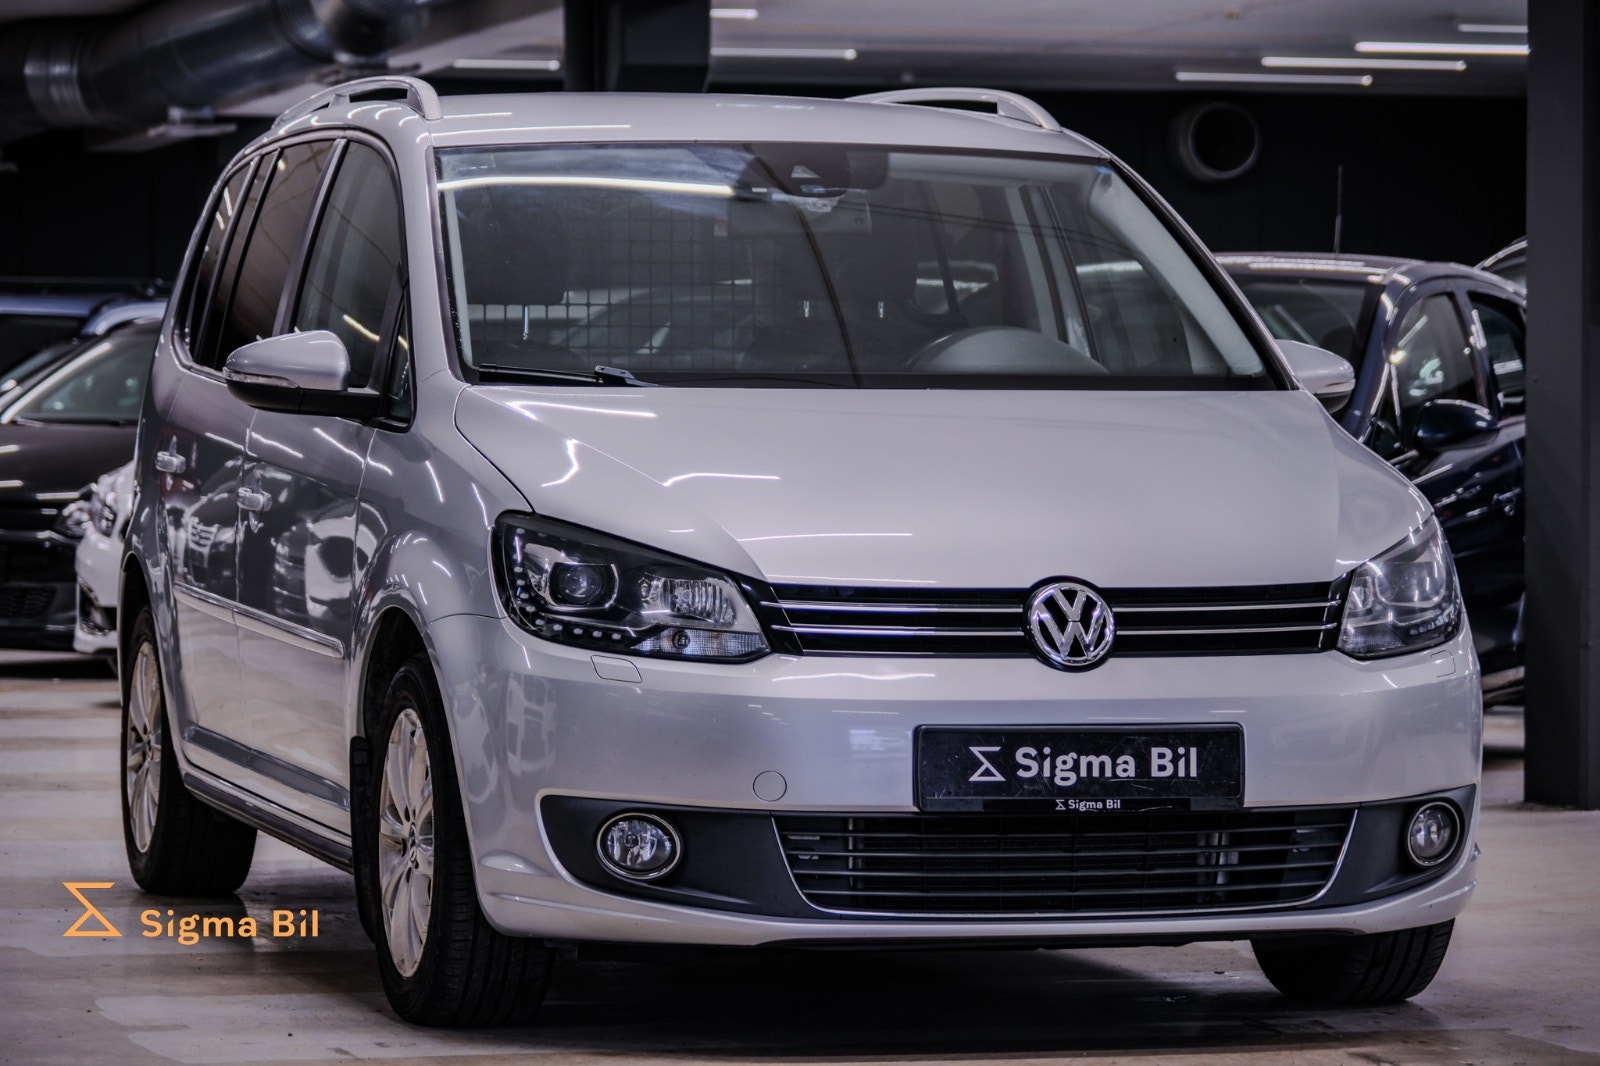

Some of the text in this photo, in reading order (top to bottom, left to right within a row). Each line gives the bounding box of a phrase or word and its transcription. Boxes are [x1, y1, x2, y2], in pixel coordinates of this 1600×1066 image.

[1015, 746, 1198, 787] Sigma Bil
[1068, 799, 1121, 811] Sigma Bil
